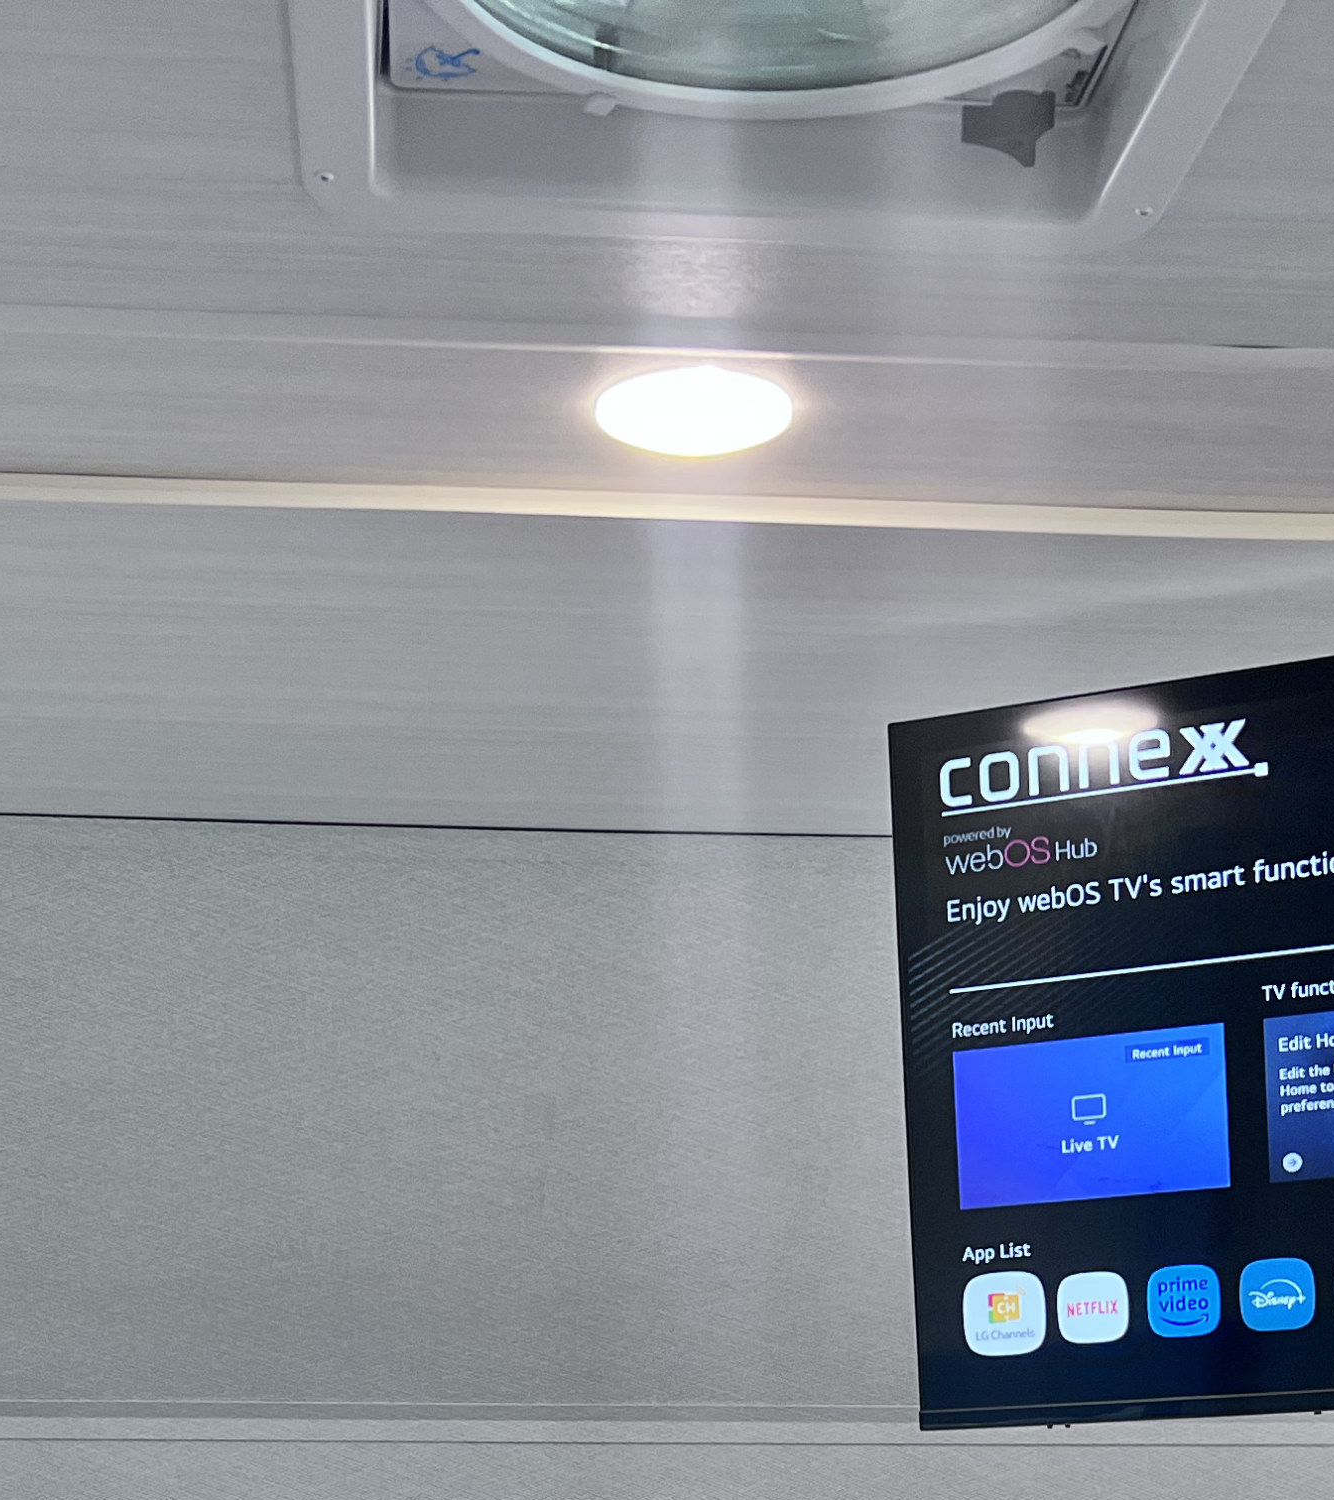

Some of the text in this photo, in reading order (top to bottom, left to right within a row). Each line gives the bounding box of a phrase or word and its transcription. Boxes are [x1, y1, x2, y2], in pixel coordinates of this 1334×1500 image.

[944, 826, 1011, 847] powered by
[946, 836, 1098, 875] webOS Hub
[946, 896, 1011, 925] Enjoy
[1017, 881, 1101, 913] webOS
[1108, 874, 1163, 901] TV's
[1171, 865, 1246, 894] smart
[1262, 984, 1285, 1001] TV
[952, 1013, 1054, 1038] Recent Input
[1132, 1043, 1202, 1060] Recent Input
[1278, 1036, 1312, 1052] Edit
[1279, 1066, 1306, 1080] Edit
[1309, 1064, 1330, 1076] the
[1280, 1083, 1316, 1096] Home
[1320, 1080, 1334, 1092] to
[1061, 1135, 1119, 1153] Live TV
[962, 1243, 1031, 1265] App List
[1157, 1277, 1209, 1296] prime
[997, 1302, 1015, 1314] CH
[1067, 1300, 1118, 1317] NETFLIX
[1158, 1296, 1209, 1313] video
[975, 1328, 1035, 1341] LG Channels
